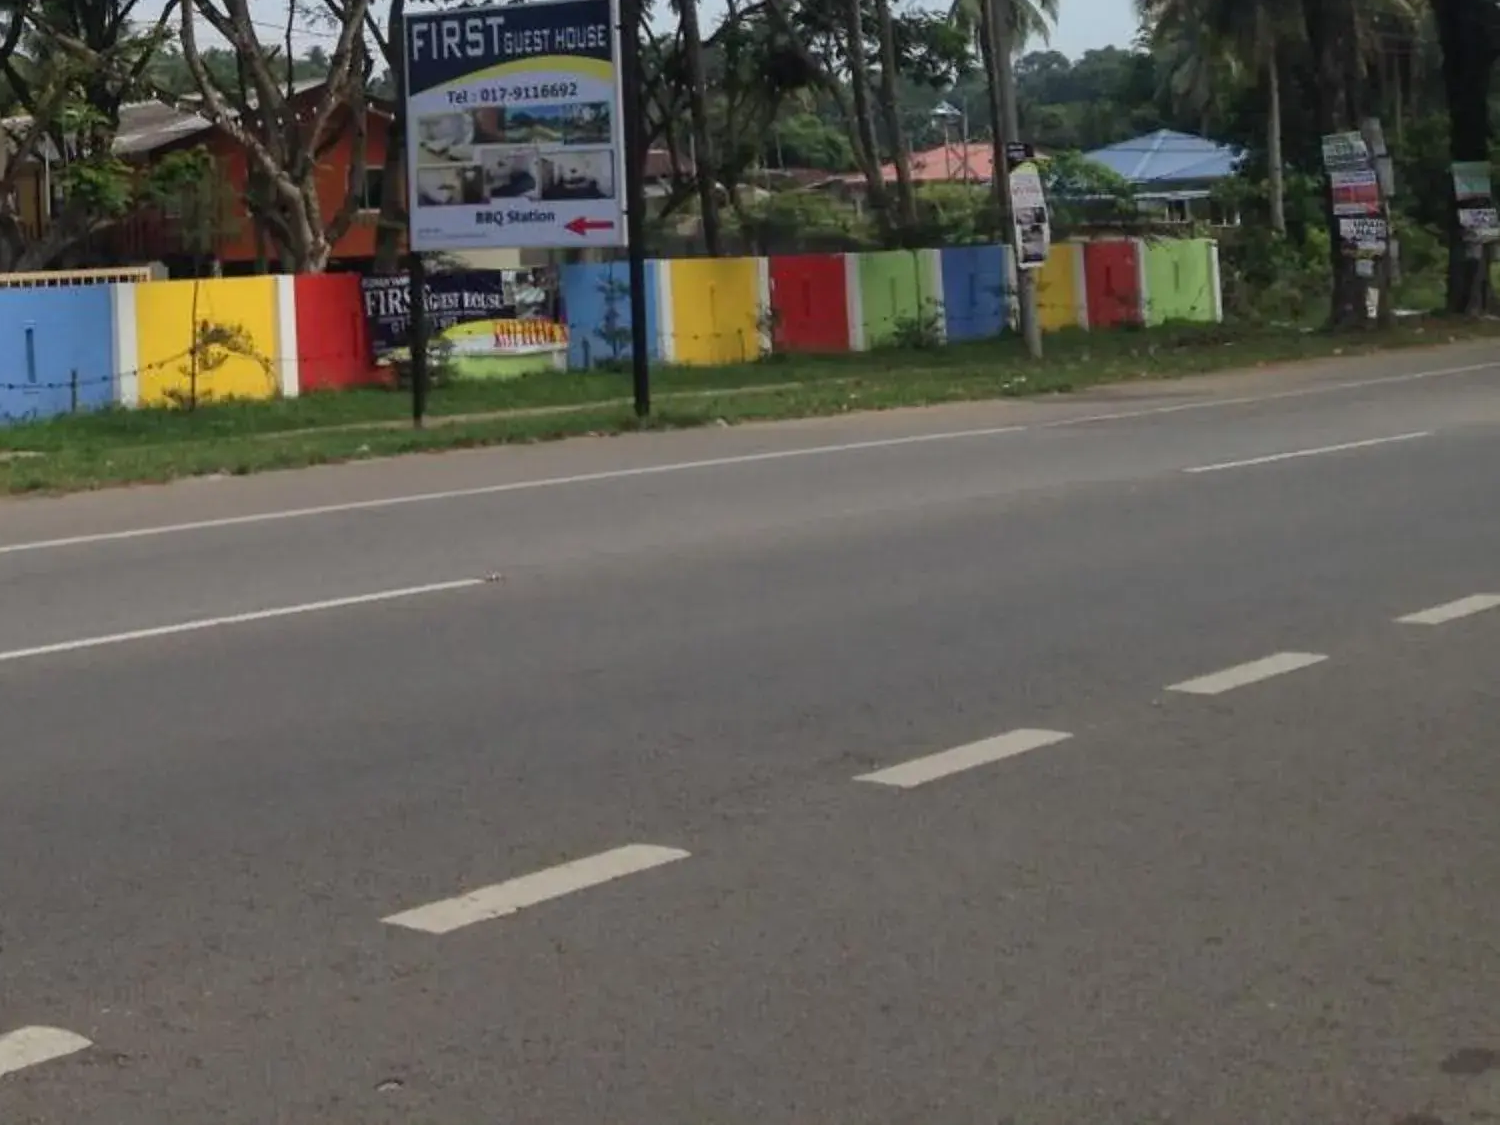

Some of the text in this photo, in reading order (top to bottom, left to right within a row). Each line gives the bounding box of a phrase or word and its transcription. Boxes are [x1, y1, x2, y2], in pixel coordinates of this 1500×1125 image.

[412, 16, 607, 61] FIRST GUEST HOUSE
[475, 208, 556, 226] BBQ Station
